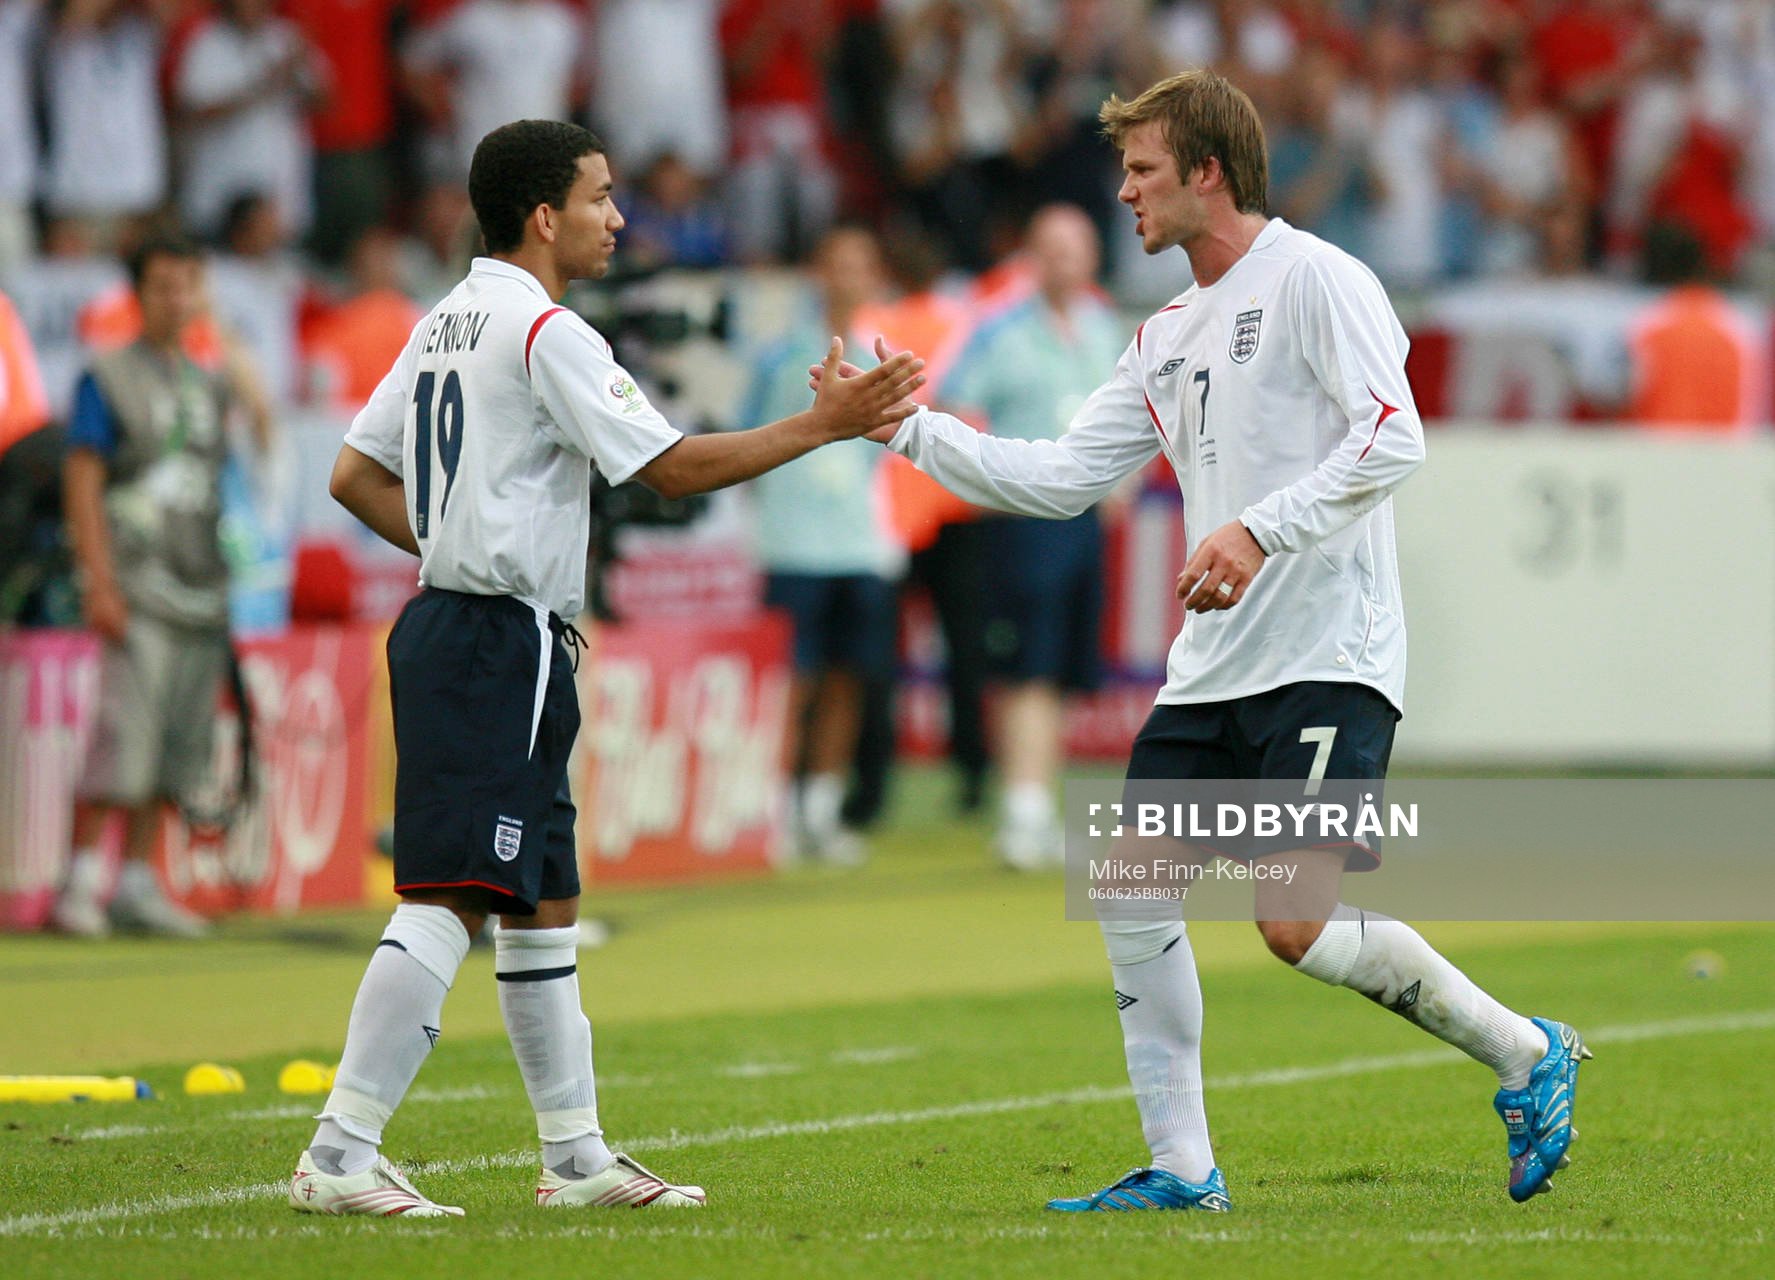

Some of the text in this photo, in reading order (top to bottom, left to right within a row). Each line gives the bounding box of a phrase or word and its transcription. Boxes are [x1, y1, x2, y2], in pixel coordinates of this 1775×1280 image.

[1193, 367, 1210, 436] 7
[413, 370, 463, 538] 19
[1299, 726, 1338, 796] 7
